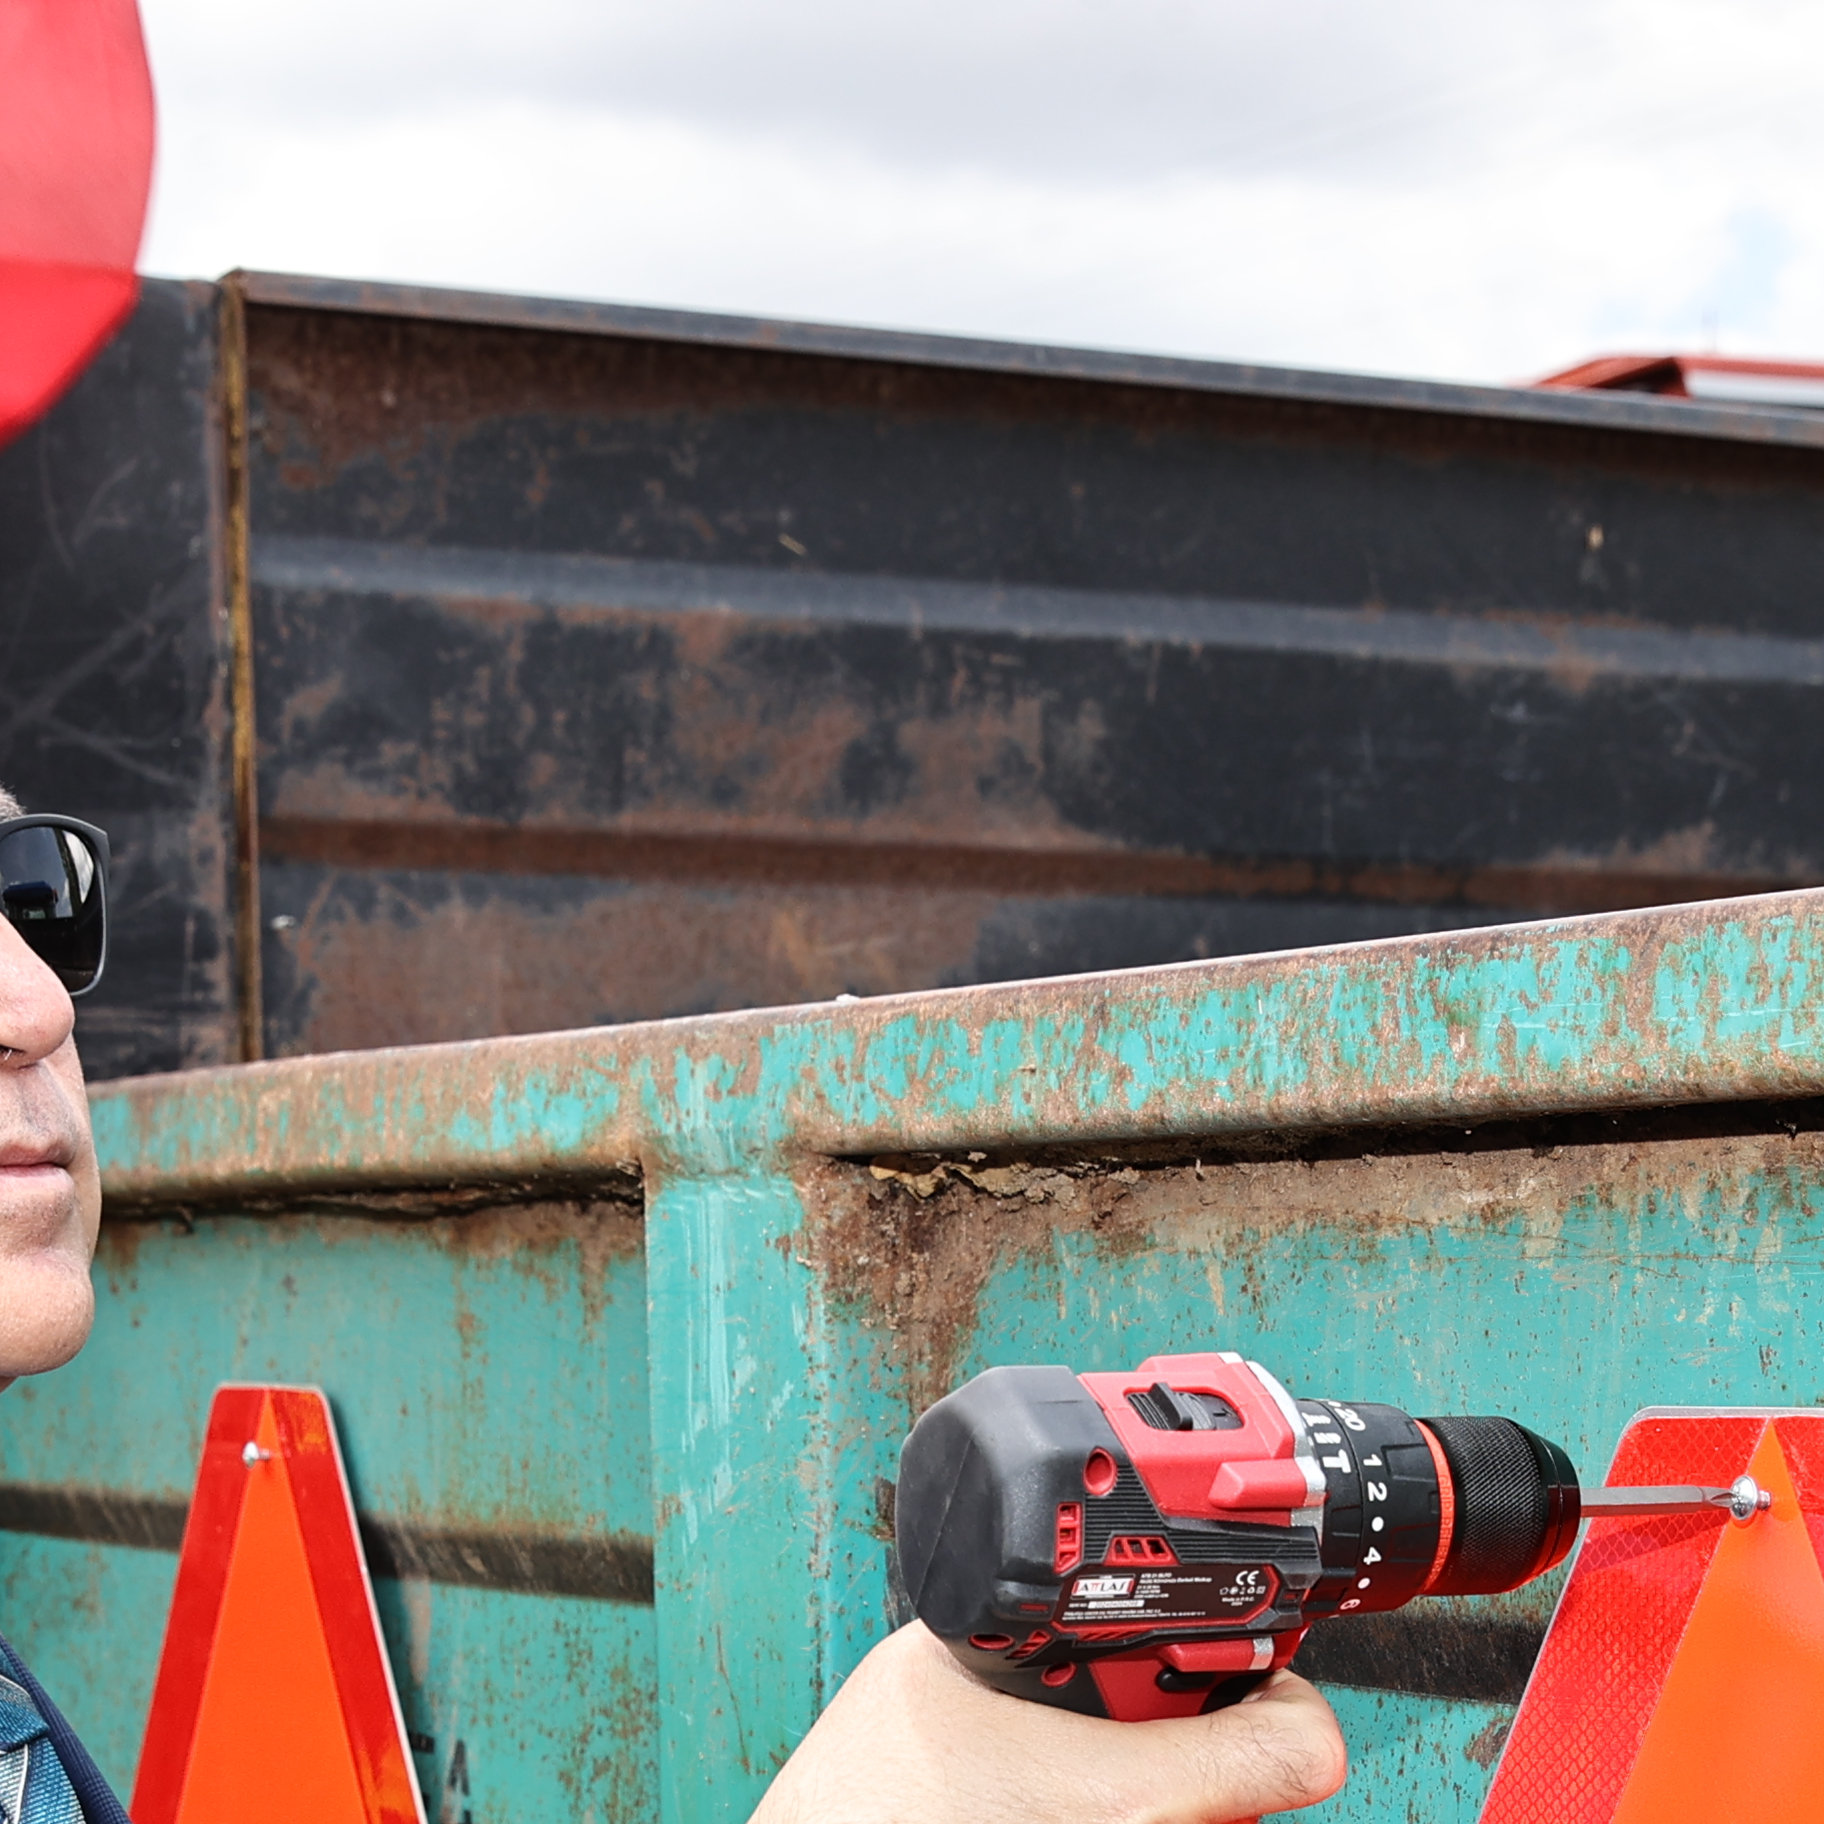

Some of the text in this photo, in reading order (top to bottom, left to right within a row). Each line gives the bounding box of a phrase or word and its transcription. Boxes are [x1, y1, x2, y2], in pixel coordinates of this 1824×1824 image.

[1334, 1408, 1366, 1432] 20
[1367, 1481, 1388, 1502] 2
[1363, 1546, 1382, 1566] 4
